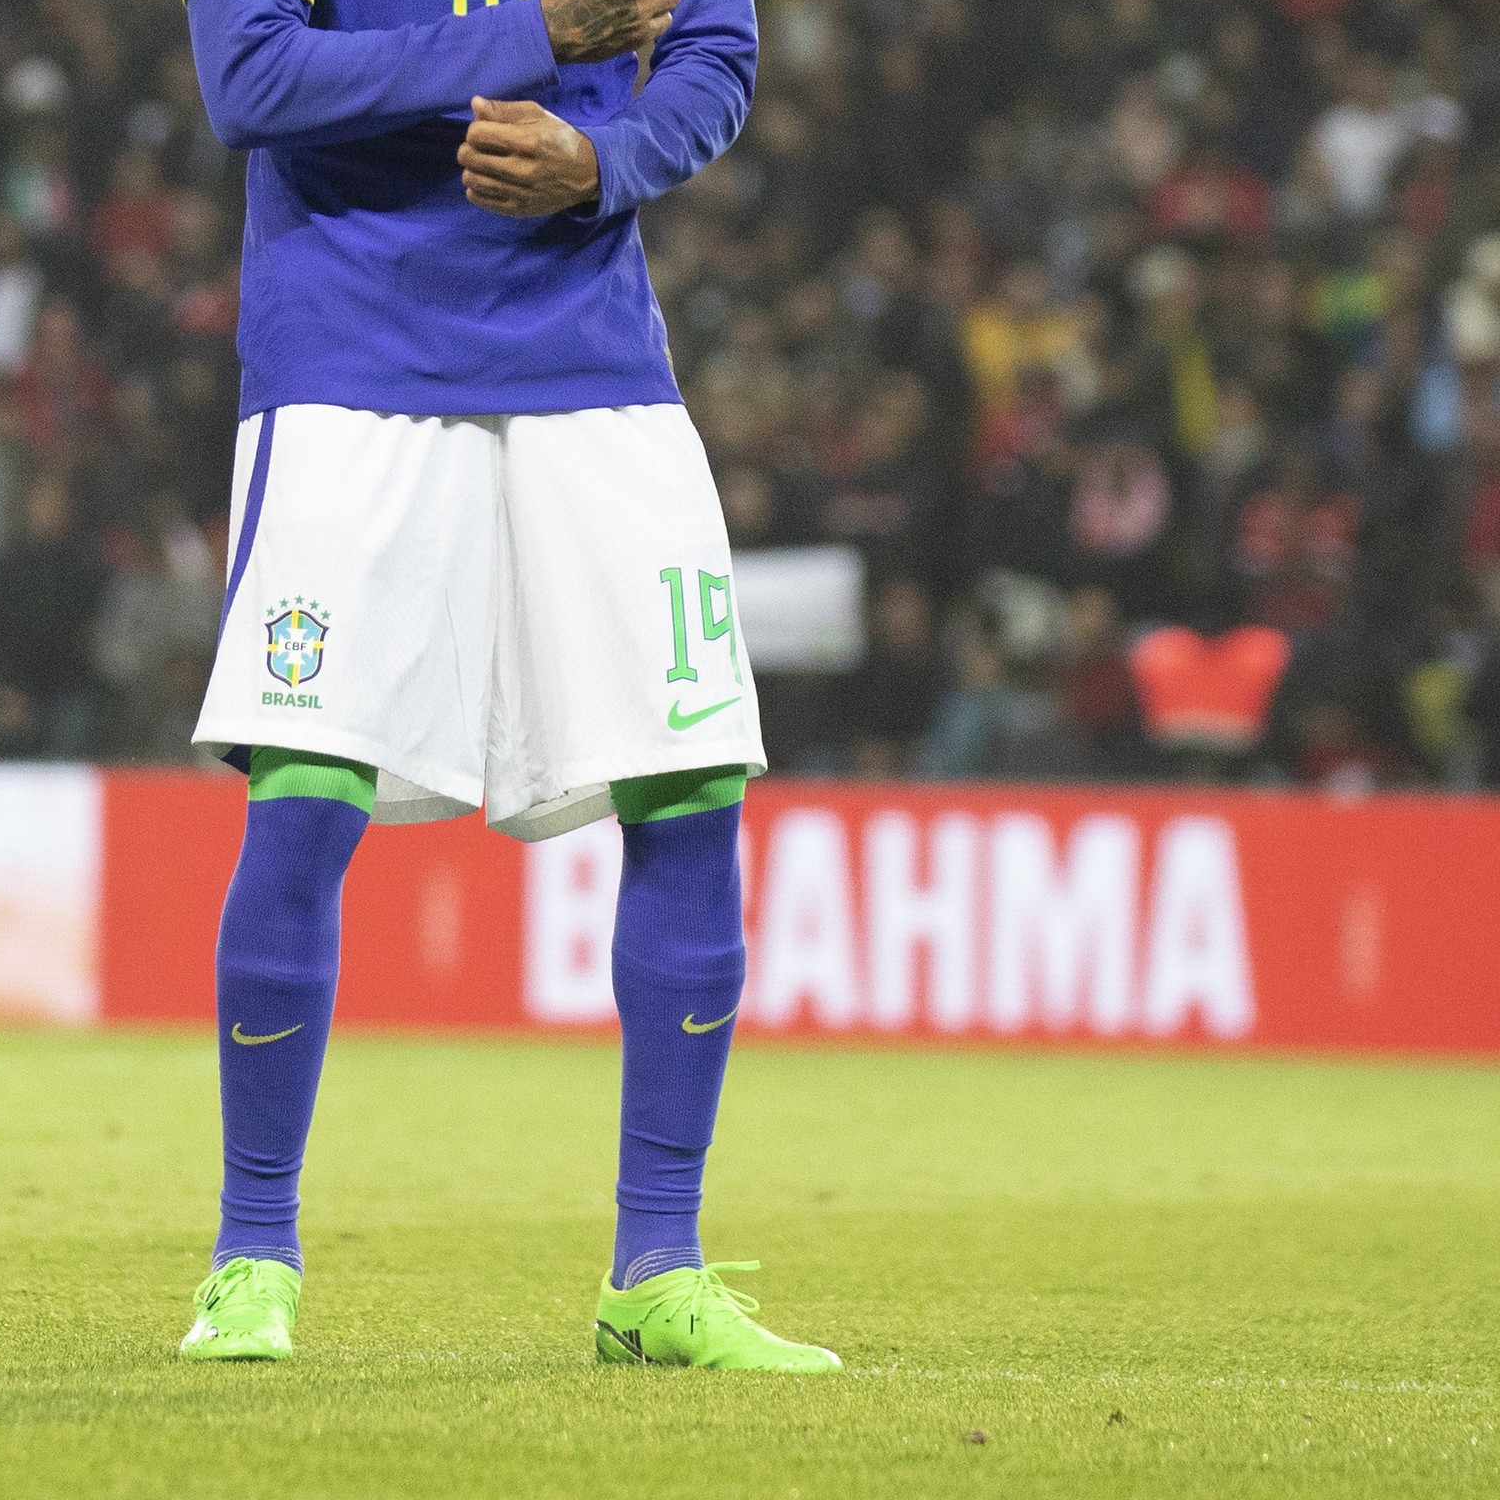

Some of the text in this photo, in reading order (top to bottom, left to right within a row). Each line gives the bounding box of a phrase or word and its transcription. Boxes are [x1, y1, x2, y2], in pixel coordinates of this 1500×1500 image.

[285, 641, 307, 651] CBF
[660, 567, 743, 686] 19
[262, 691, 323, 709] BRASIL
[526, 809, 1254, 1038] BAHMA
